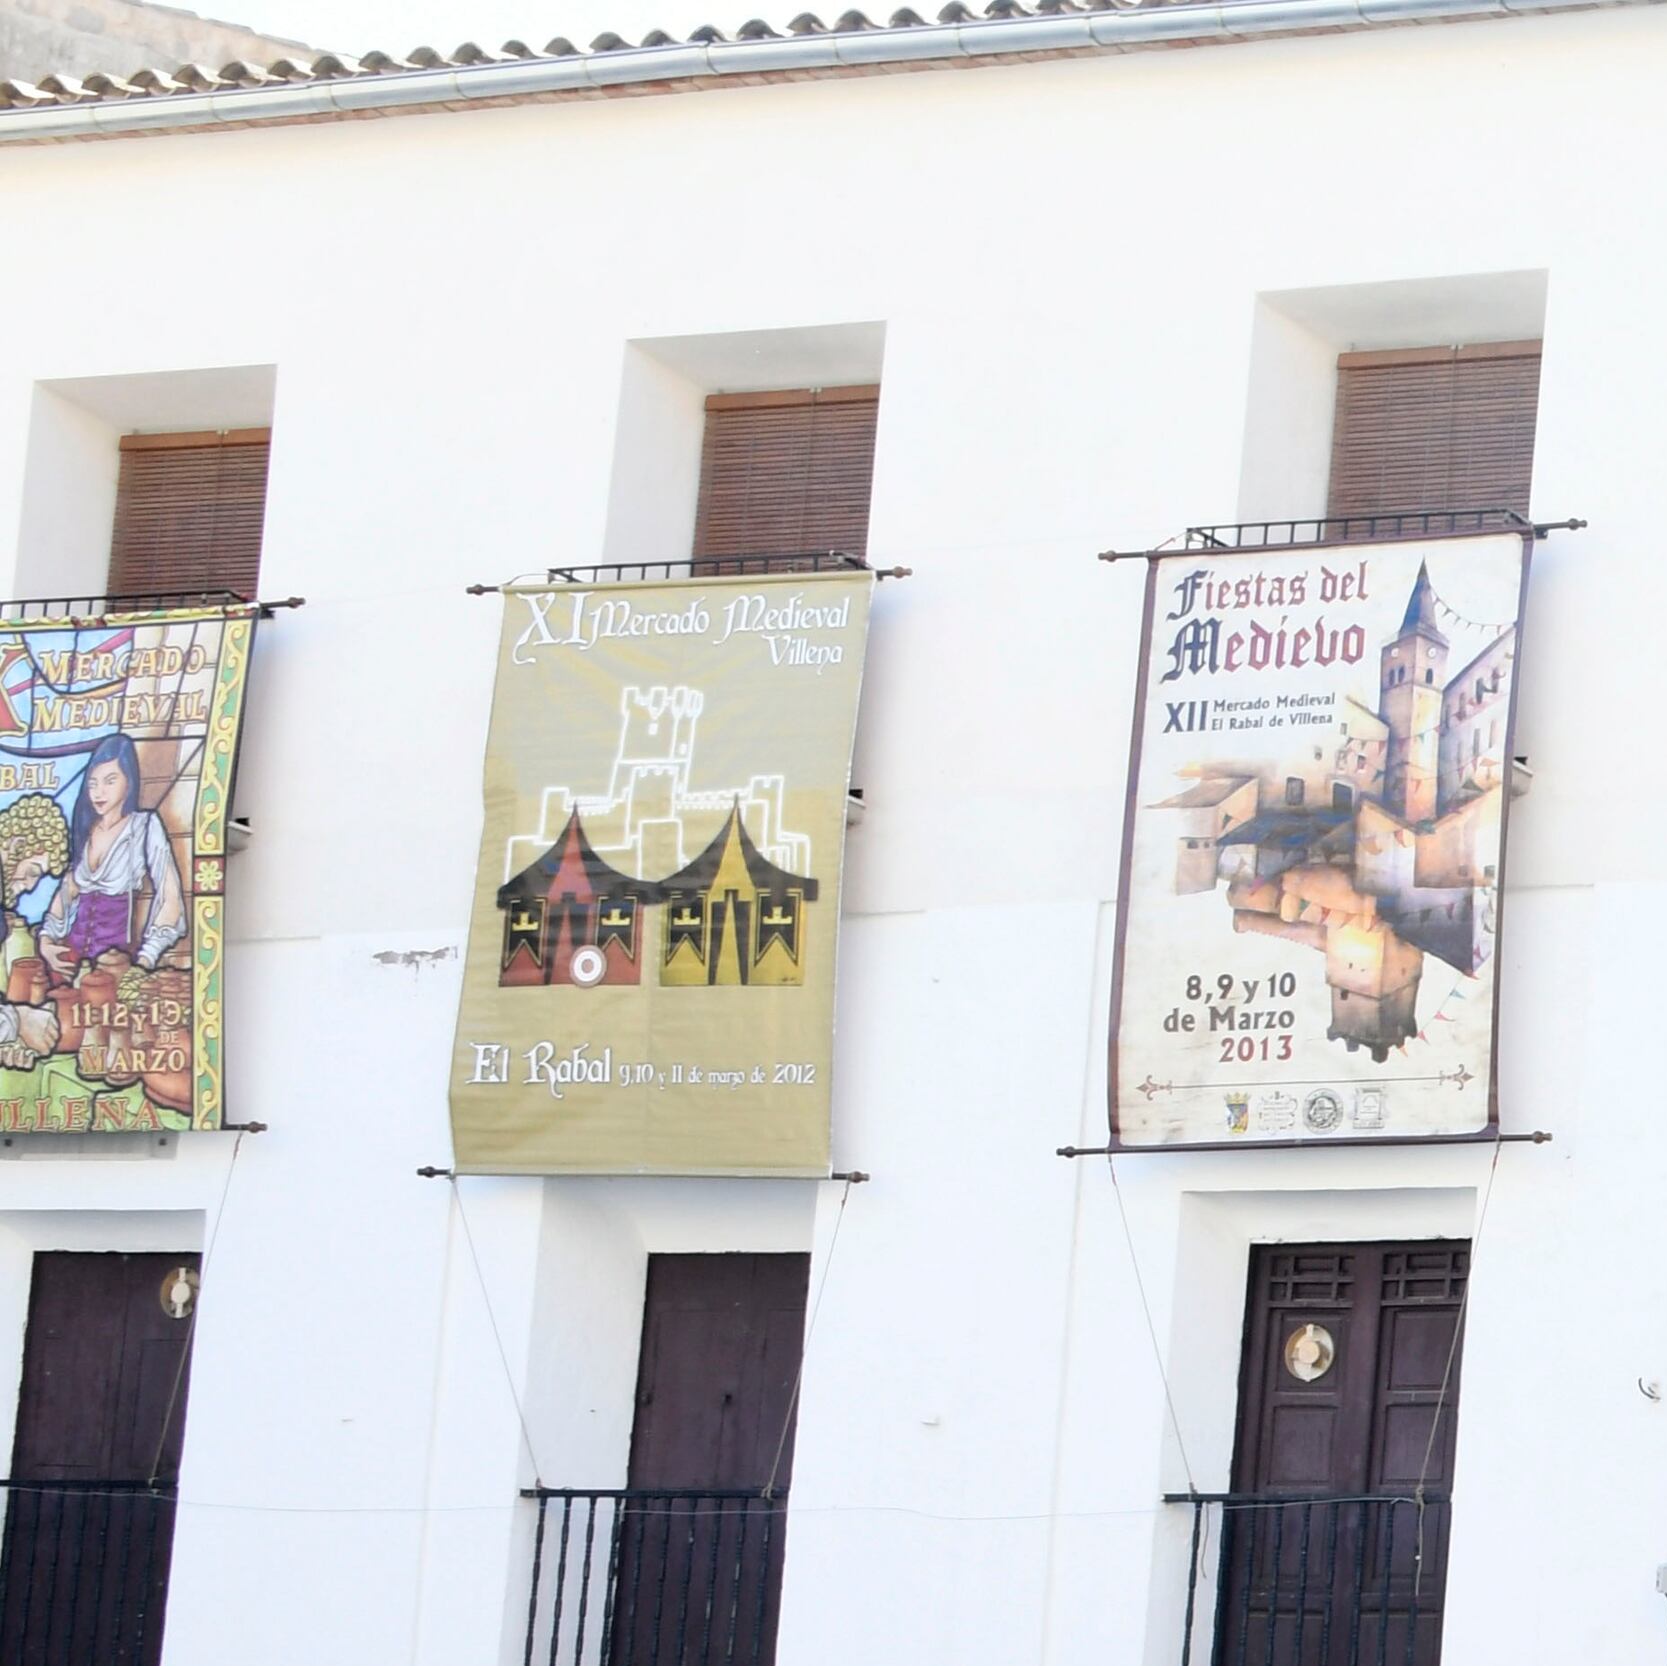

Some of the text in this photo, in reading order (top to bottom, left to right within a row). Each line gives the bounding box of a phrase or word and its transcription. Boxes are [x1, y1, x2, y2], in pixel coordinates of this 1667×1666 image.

[1166, 560, 1369, 621] Fiestas del
[513, 591, 849, 664] XI Mercado Medieval
[36, 645, 205, 685] MERCADO
[761, 635, 843, 676] Villena
[1159, 615, 1366, 684] Medievo
[32, 690, 206, 732] MEDIEVAL
[1162, 700, 1208, 734] XII
[1213, 692, 1336, 712] Mercado Medieval
[1211, 712, 1333, 731] El Rabal de Villena
[0, 762, 59, 790] BAL
[1242, 980, 1259, 1004] y
[1268, 972, 1296, 998] 10
[131, 1014, 147, 1033] Y
[1163, 1006, 1295, 1032] de Marzo
[159, 1030, 178, 1045] DE
[1219, 1034, 1293, 1062] 2013
[80, 1047, 185, 1075] MARZO
[465, 1042, 508, 1084] El
[522, 1041, 610, 1099] Rabal
[658, 1072, 666, 1090] y
[672, 1064, 682, 1084] 11
[687, 1065, 702, 1084] de
[707, 1070, 744, 1090] marzo
[750, 1065, 765, 1084] de
[772, 1064, 816, 1084] 2012
